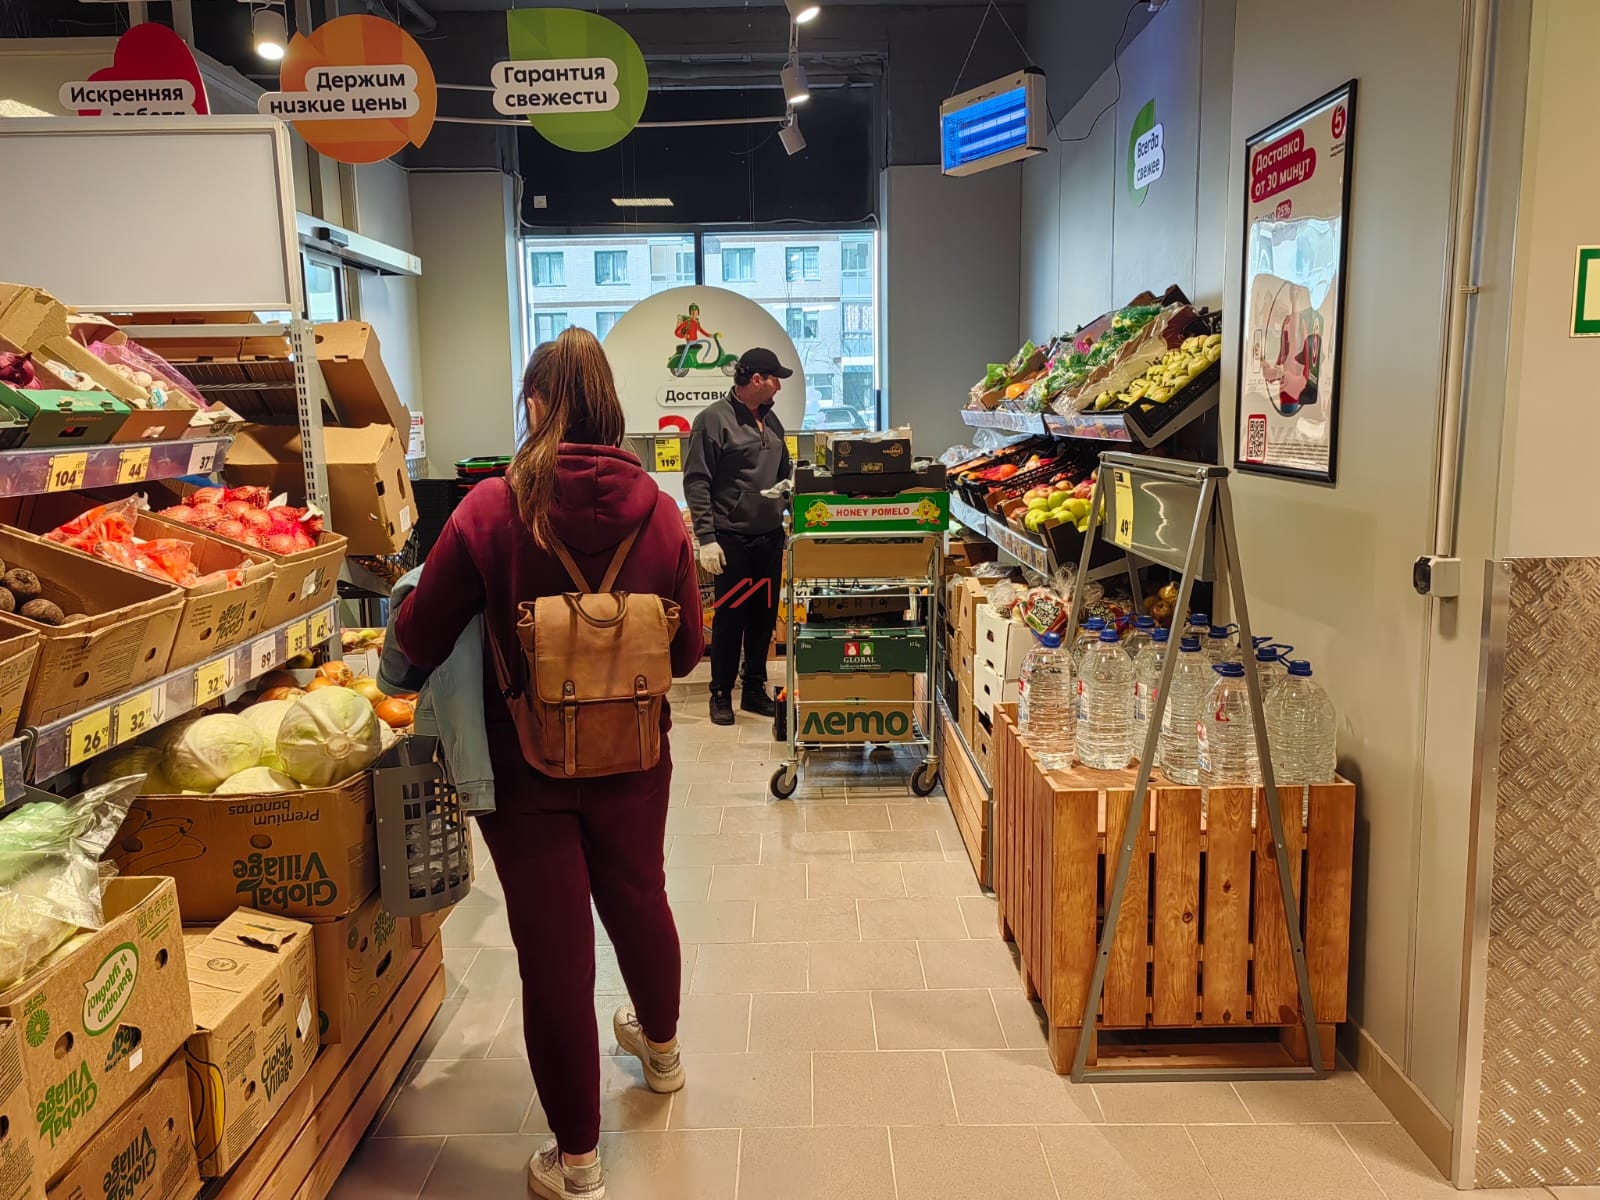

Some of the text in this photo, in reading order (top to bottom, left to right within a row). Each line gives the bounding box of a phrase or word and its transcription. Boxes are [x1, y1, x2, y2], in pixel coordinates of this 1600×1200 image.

[316, 72, 405, 92] Держим
[504, 66, 606, 87] Гарантия
[71, 87, 184, 106] Искренняя
[270, 97, 407, 114] низкие цены
[505, 90, 608, 107] свежести
[1137, 133, 1160, 159] Всегда
[1256, 137, 1300, 175] Доставка
[1137, 158, 1160, 181] свежее
[1255, 158, 1311, 197] от 30 минут
[665, 390, 727, 403] Доставк
[128, 463, 141, 478] 44
[661, 459, 675, 467] 119
[55, 470, 77, 487] 104
[836, 507, 910, 517] HONEY POMELO
[1121, 520, 1129, 536] 49
[261, 652, 272, 669] 89
[208, 678, 219, 695] 32
[130, 711, 145, 732] 32
[83, 730, 101, 754] 26
[228, 800, 291, 815] bananas
[253, 808, 320, 826] Premium
[232, 852, 329, 881] Village
[119, 953, 129, 965] и
[97, 967, 134, 1023] Выгодно
[36, 1059, 93, 1123] Village
[103, 1126, 153, 1193] Village
